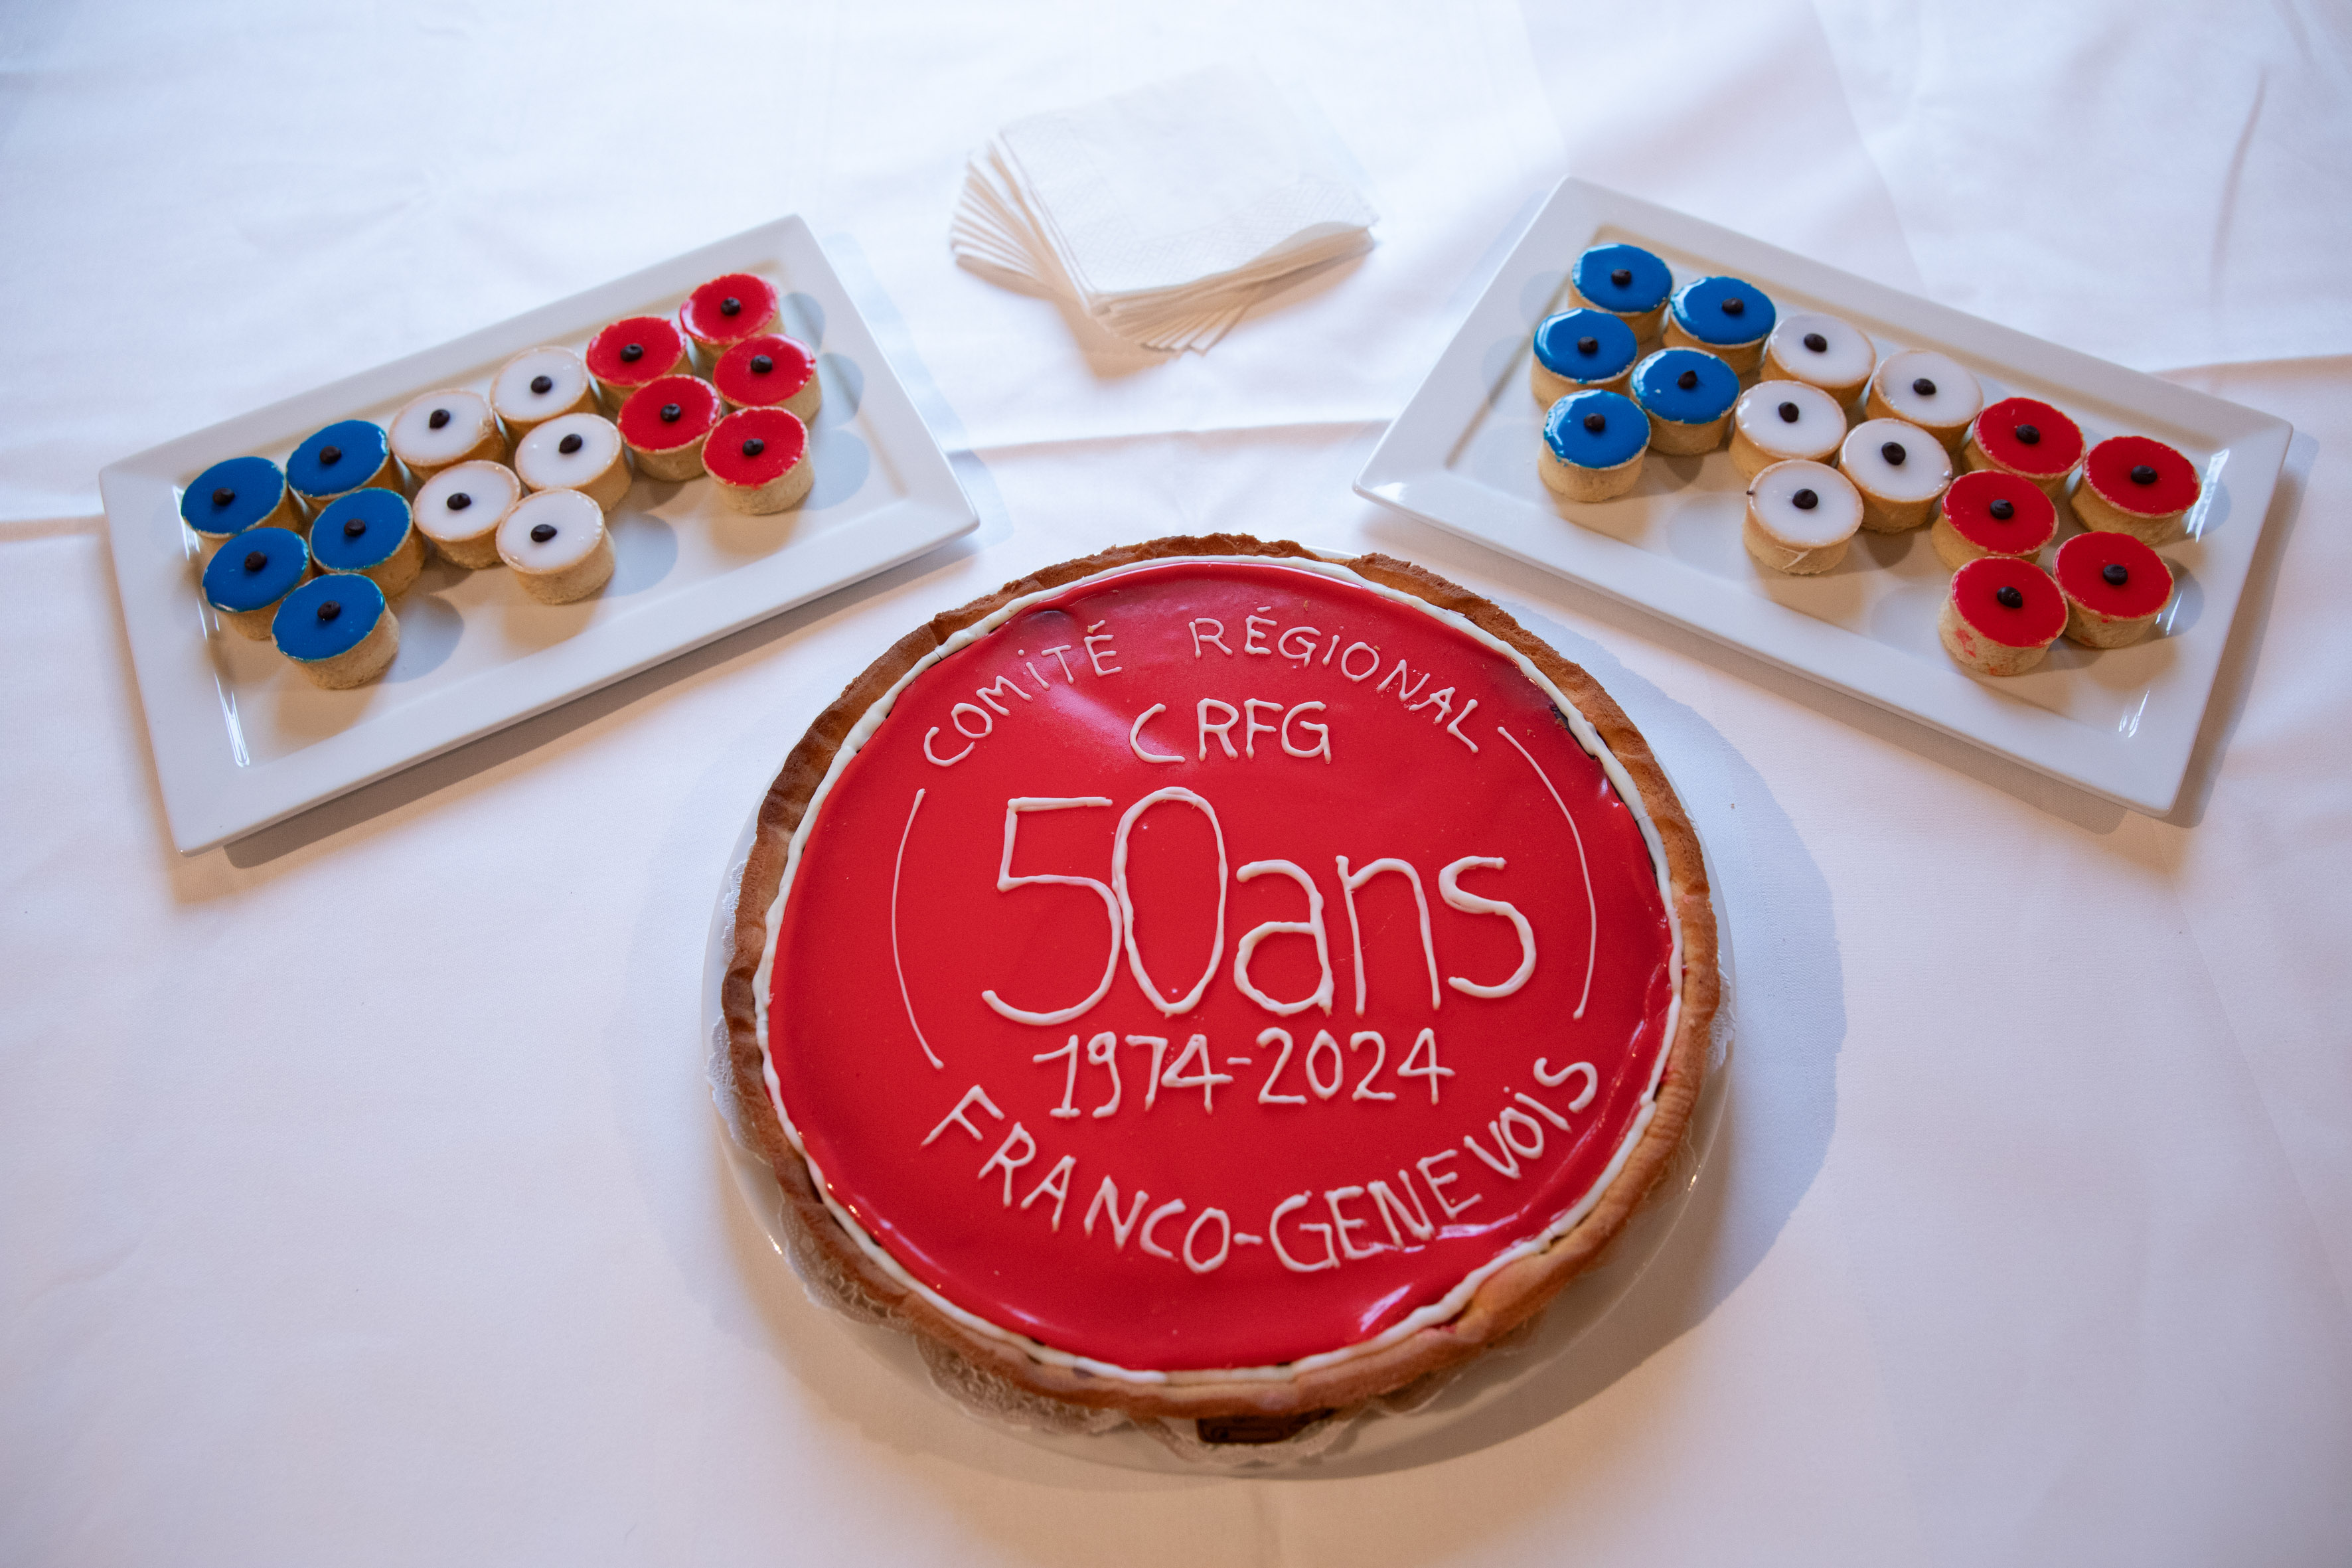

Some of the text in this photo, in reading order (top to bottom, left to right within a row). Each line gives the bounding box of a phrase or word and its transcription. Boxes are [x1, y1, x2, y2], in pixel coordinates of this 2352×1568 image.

[1188, 605, 1479, 753] RÉGIONAL
[1129, 697, 1332, 765] CRFG
[1033, 1027, 1455, 1118] 1974-2024
